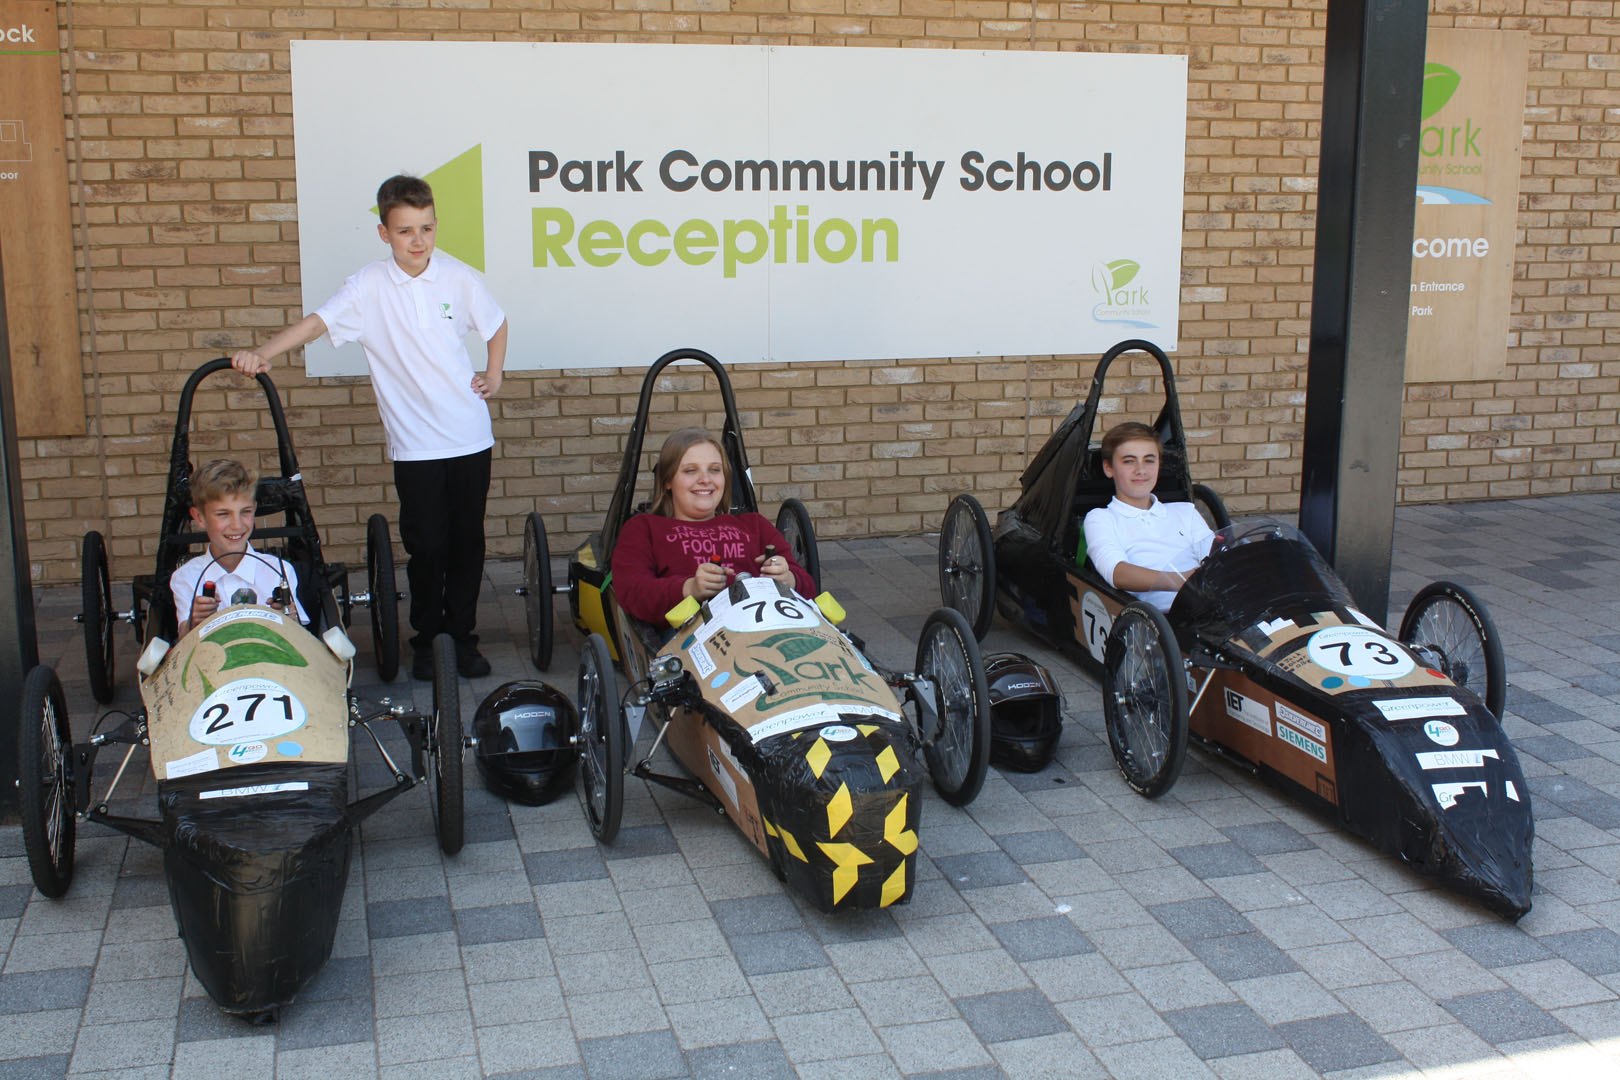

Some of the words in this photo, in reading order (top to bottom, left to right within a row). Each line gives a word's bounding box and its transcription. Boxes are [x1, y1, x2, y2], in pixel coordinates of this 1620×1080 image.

[528, 150, 643, 193] Park
[659, 150, 945, 200] Community
[959, 150, 1113, 192] School
[1447, 164, 1482, 176] School
[531, 205, 899, 278] Reception
[1420, 281, 1465, 292] Entrance
[1411, 306, 1433, 316] Park
[723, 542, 746, 559] ME
[742, 600, 804, 624] 76
[1319, 641, 1400, 667] 73
[203, 693, 294, 735] 271
[1381, 701, 1450, 712] Greenpower
[1279, 725, 1326, 760] SIEMENS
[1434, 753, 1470, 766] BMW
